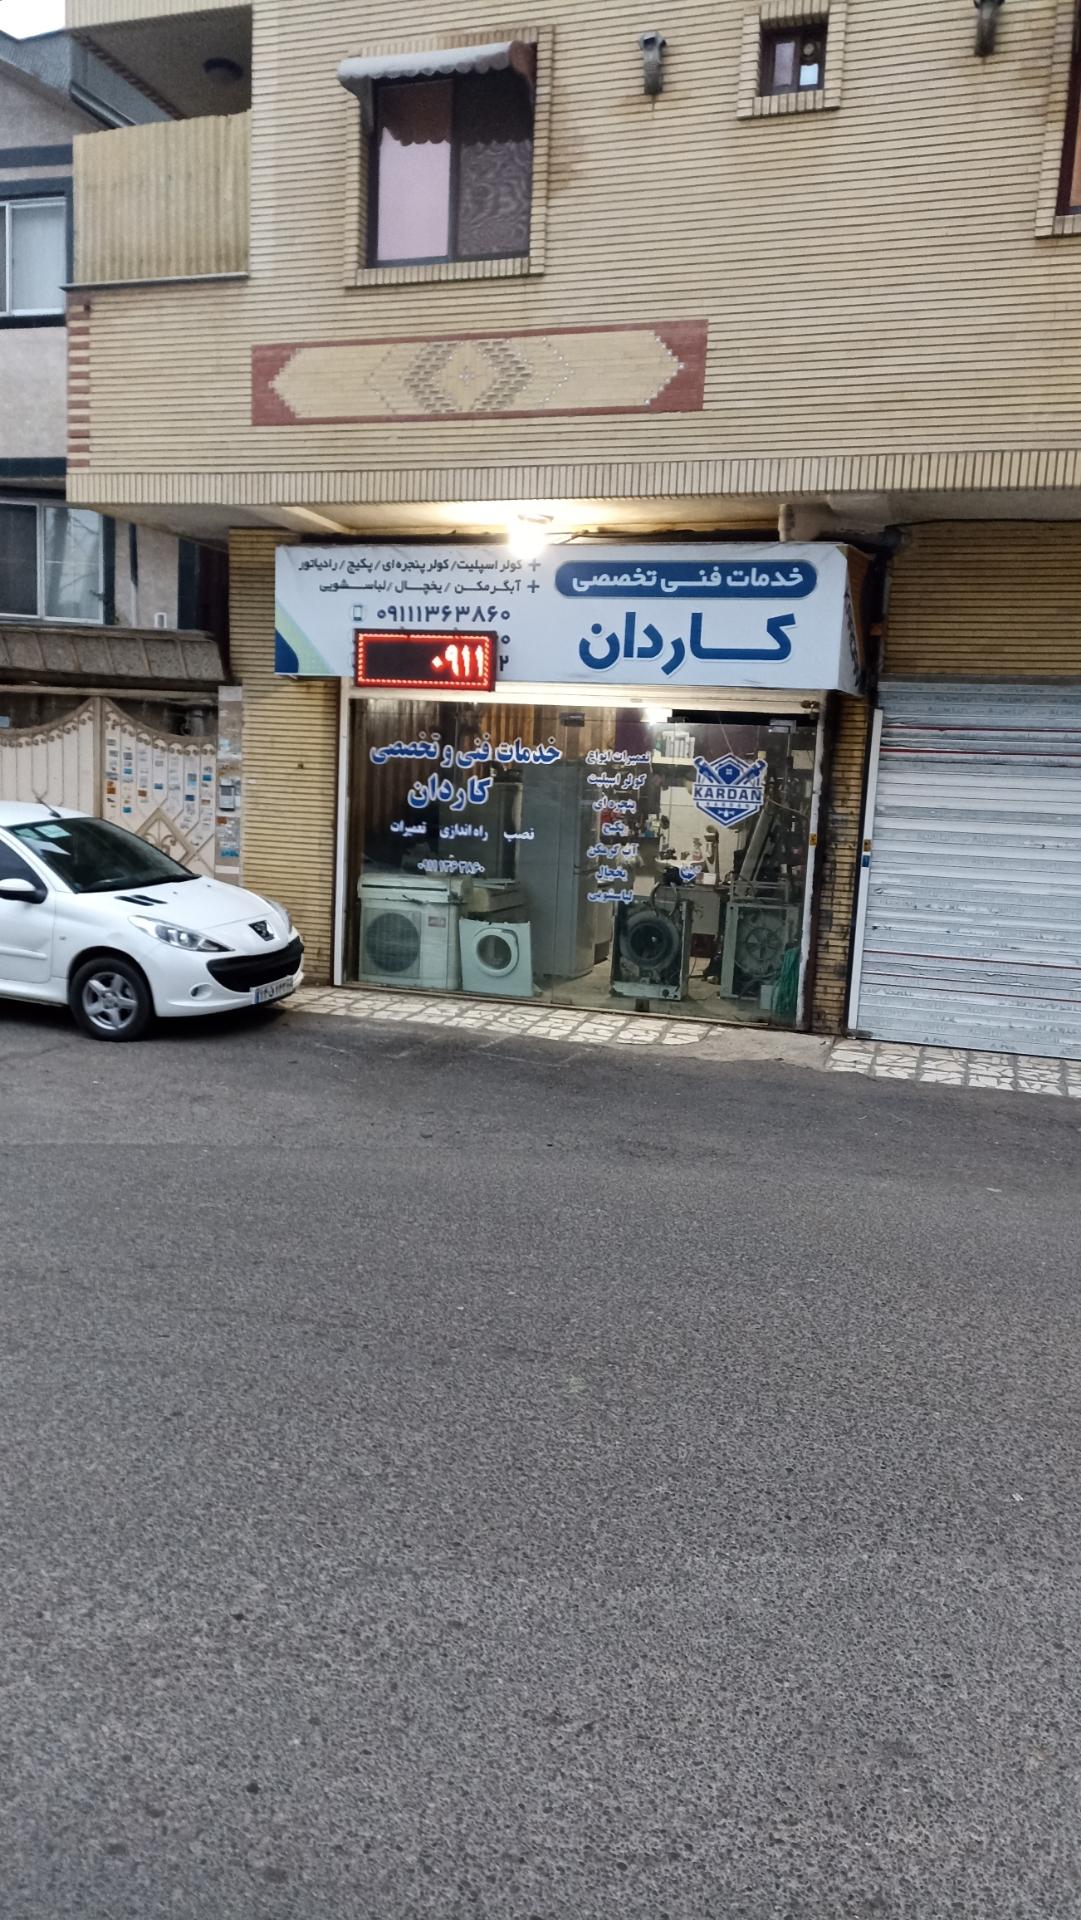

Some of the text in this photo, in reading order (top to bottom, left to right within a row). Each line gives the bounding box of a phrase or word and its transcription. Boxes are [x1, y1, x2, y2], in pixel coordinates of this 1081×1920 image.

[298, 558, 338, 572] رادیاتور
[346, 558, 373, 575] پکیج
[429, 558, 449, 572] کولر
[499, 559, 523, 573] کولر
[394, 579, 443, 595] یخچال
[572, 566, 804, 593] خدمات فنی تخصصی
[377, 605, 511, 623] ۰۹۱۱۱۳۶۳۸۶۰
[578, 611, 797, 677] کاردان
[369, 730, 563, 769] خدمات فنی و تخصصی
[585, 748, 652, 767] تعمیرات انواع
[587, 771, 647, 790] کولر اسپلیت
[407, 771, 494, 811] کاردان
[694, 787, 762, 801] KARDAN
[389, 819, 427, 838] تعمیرات
[503, 827, 535, 843] نصب
[595, 865, 628, 882] یخچال
